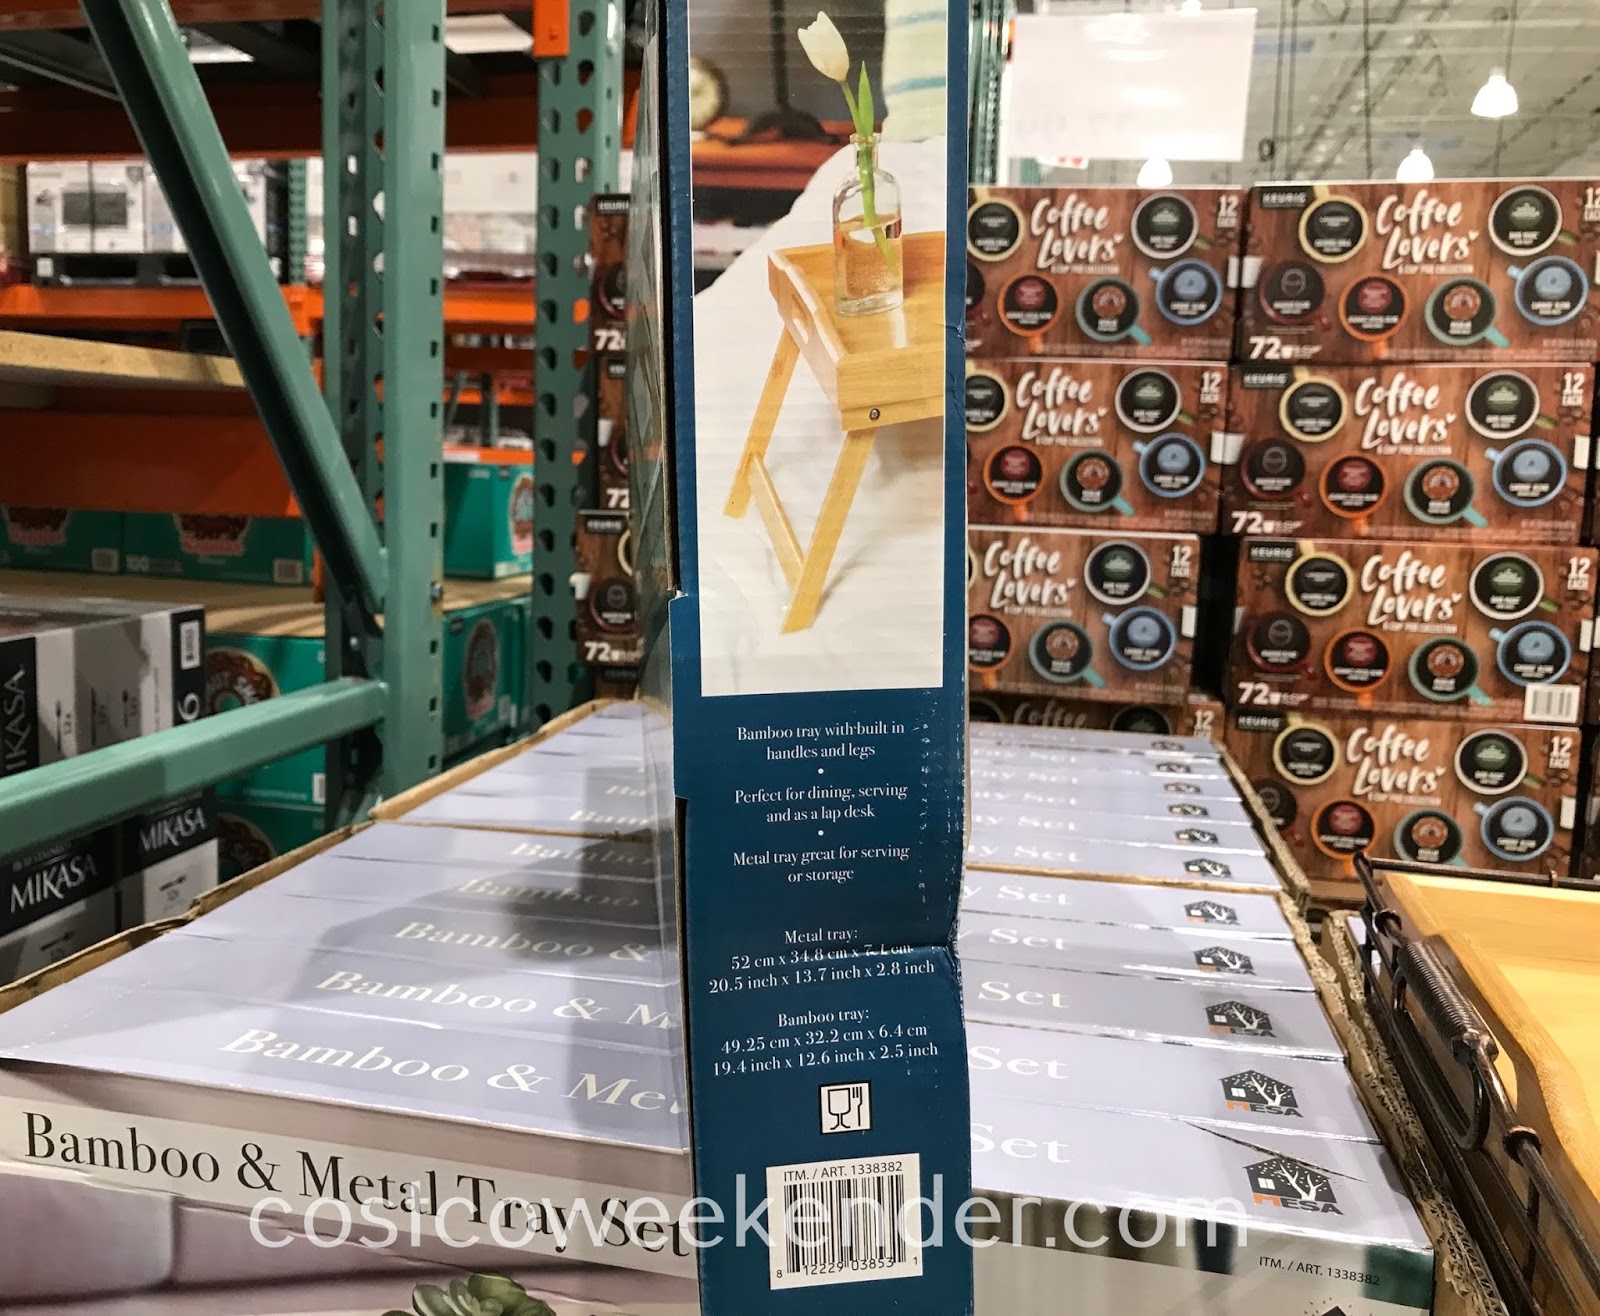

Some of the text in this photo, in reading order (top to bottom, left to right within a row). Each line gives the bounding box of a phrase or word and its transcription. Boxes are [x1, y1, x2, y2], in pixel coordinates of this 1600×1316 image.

[1030, 192, 1109, 237] Coffee
[1219, 194, 1239, 216] 12
[1376, 188, 1463, 236] Coffee
[1249, 336, 1281, 359] 72
[1016, 366, 1094, 410] Coffee
[1202, 371, 1221, 392] 12
[1563, 372, 1585, 393] 12
[1354, 372, 1441, 418] Coffee
[1231, 511, 1263, 534] 72
[984, 537, 1061, 579] Coffee
[1171, 545, 1192, 567] 12
[1568, 556, 1591, 578] 12
[1360, 550, 1447, 594] Coffee
[1238, 682, 1270, 705] 72
[3, 667, 32, 771] IKASA
[737, 725, 793, 741] Bamboo
[796, 726, 821, 741] tray
[891, 720, 905, 734] in
[766, 742, 875, 760] handles and legs
[1346, 724, 1432, 766] Coffee
[1550, 736, 1572, 754] 12
[735, 783, 908, 804] Perfect for dining, serving
[766, 804, 875, 823] and as a lap desk
[140, 806, 206, 852] MIKASA
[733, 845, 910, 867] Metal tray great for serving
[10, 853, 99, 914] MIKASA
[787, 868, 854, 884] or storage
[458, 878, 639, 907] Bamboo
[395, 921, 652, 964] Bamboo &
[784, 927, 859, 945] Metal tray:
[988, 928, 1072, 950] Set
[731, 955, 750, 971] 52
[754, 955, 775, 968] cm
[778, 955, 786, 965] x
[790, 948, 823, 964] 34.8
[827, 948, 848, 960] cm
[851, 947, 859, 958] x
[709, 960, 935, 994] 20.5 inch x 13.7 inch x 2.8 inch
[316, 970, 537, 1014] Bamboo
[553, 997, 612, 1021] &
[978, 980, 1070, 1008] Set
[777, 1008, 869, 1028] Bamboo tray:
[721, 1023, 928, 1055] 49.25 cm x 32.2 cm x 6.4 cm
[217, 1029, 470, 1082] Bamboo
[486, 1064, 553, 1094] &
[713, 1042, 938, 1076] 19.4 inch x 12.6 inch x 2.5 inch
[969, 1045, 1069, 1081] Set
[1226, 1099, 1304, 1118] MESA
[971, 1122, 1071, 1164] Set
[21, 1110, 690, 1257] Bamboo & Metal Tray Set
[784, 1161, 903, 1182] ITM. / ART. 1338382
[1253, 1193, 1344, 1216] MESA
[776, 1256, 918, 1279] 8 12229 03853 1
[1259, 1255, 1381, 1287] ITM. / ART. 1338382
